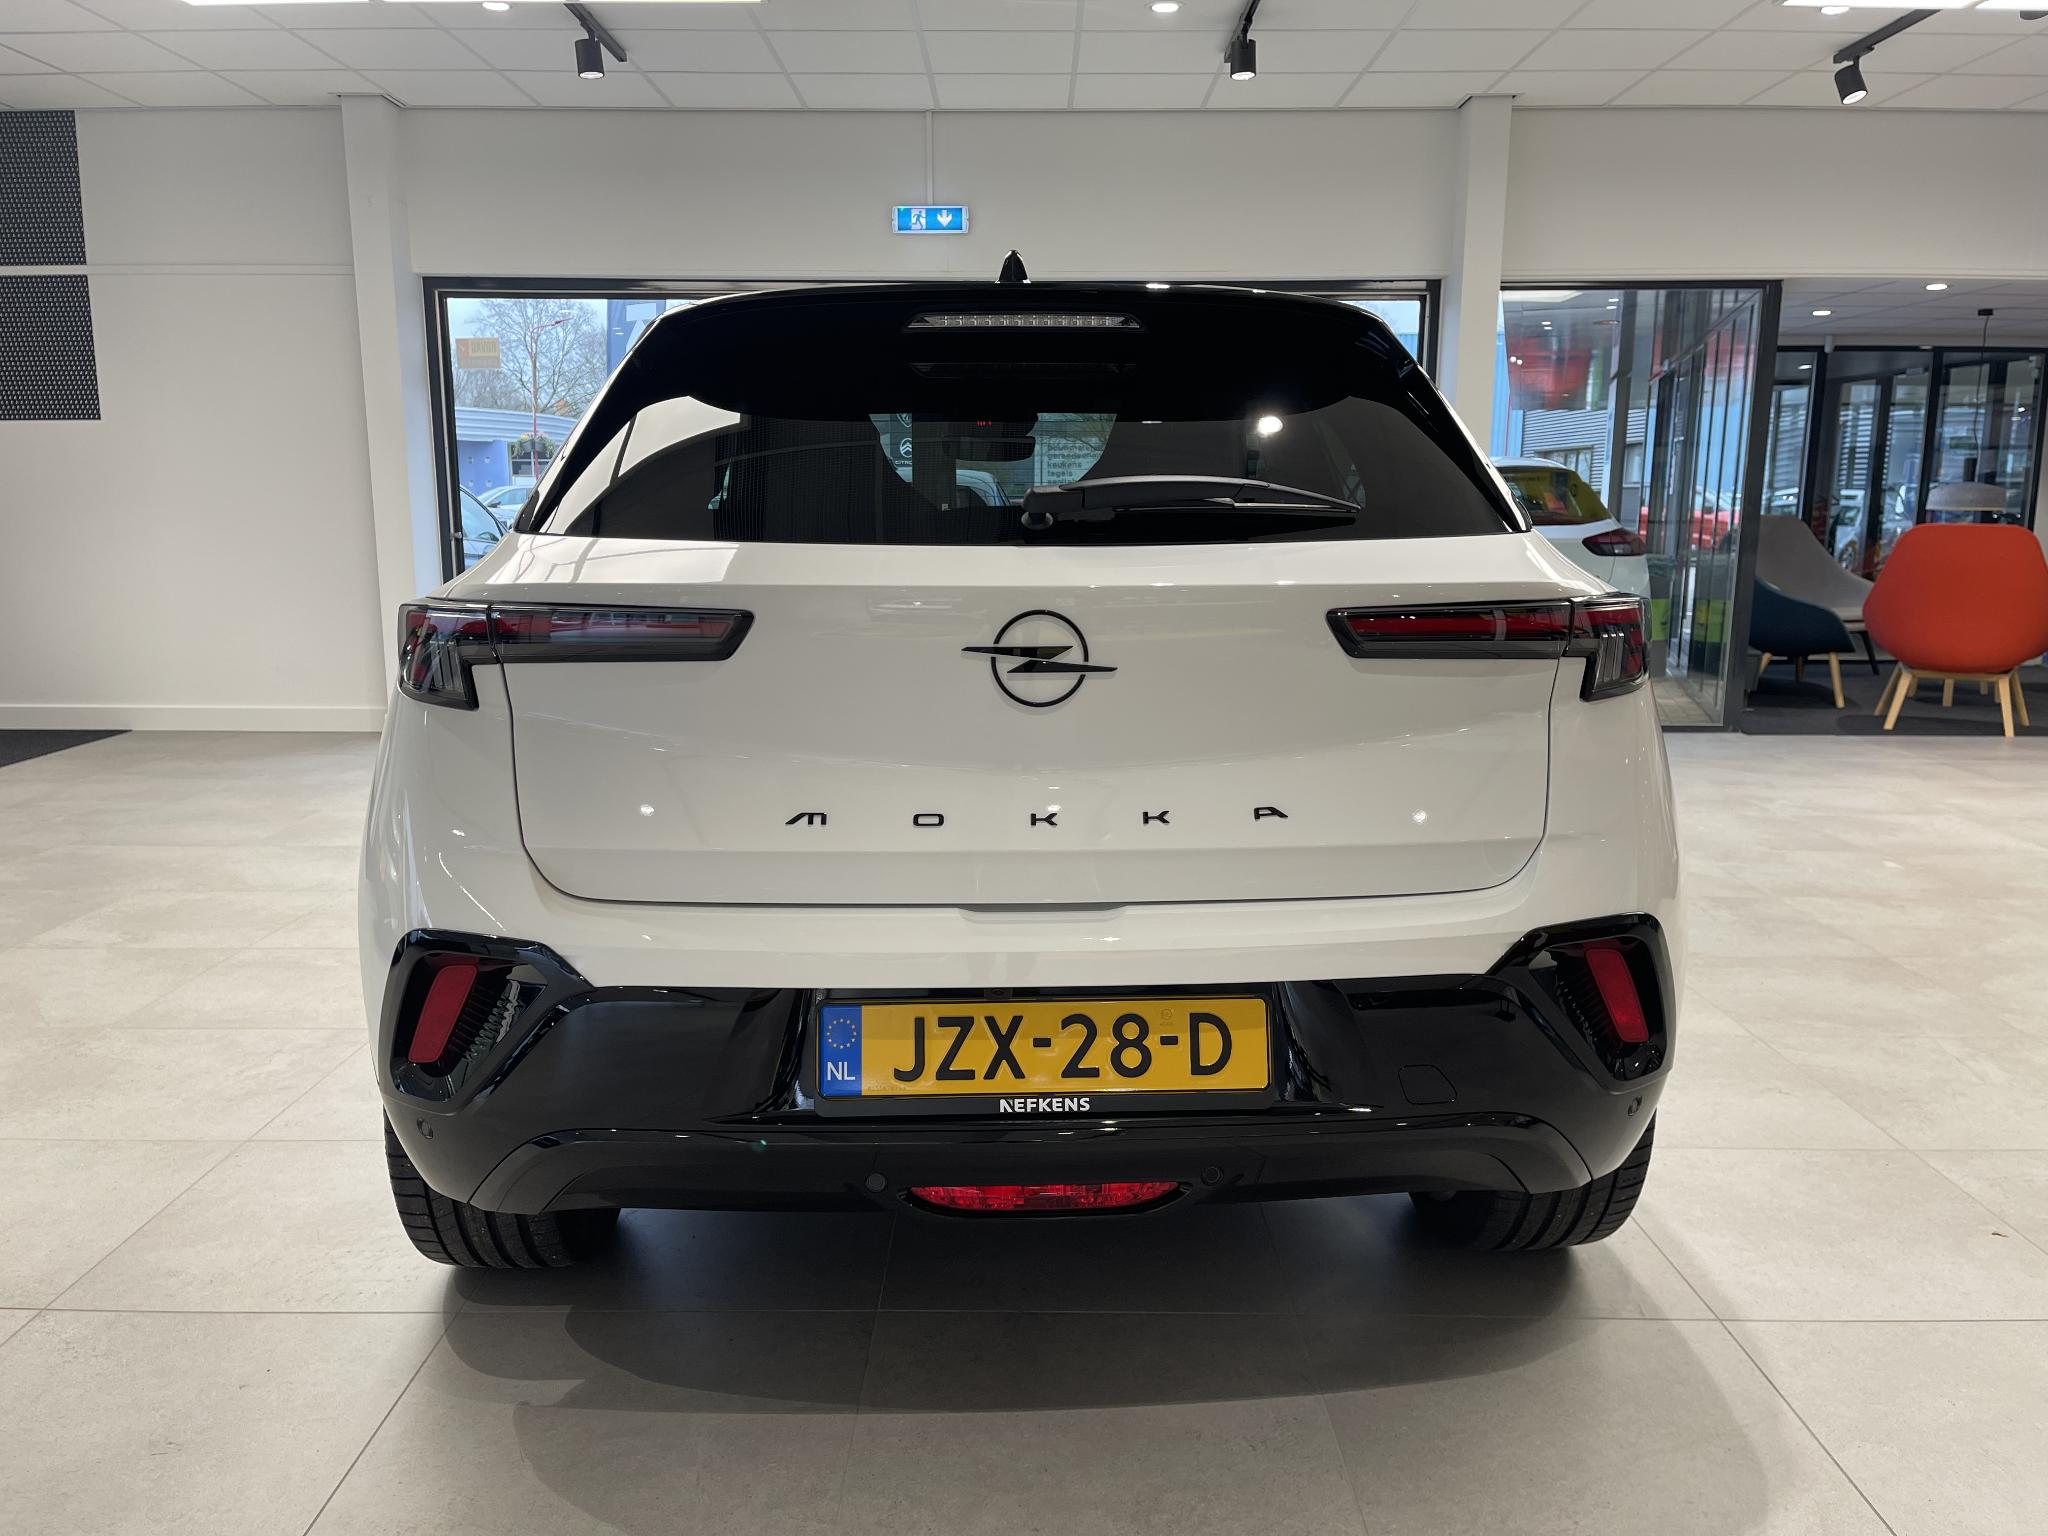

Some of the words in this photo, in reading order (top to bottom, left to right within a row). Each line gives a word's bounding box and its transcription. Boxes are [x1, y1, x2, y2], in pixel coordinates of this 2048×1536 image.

[785, 806, 1288, 827] MOKKA
[893, 1012, 1233, 1083] JZX-28-D
[827, 1061, 856, 1081] NL
[999, 1097, 1091, 1113] NEFKENS
